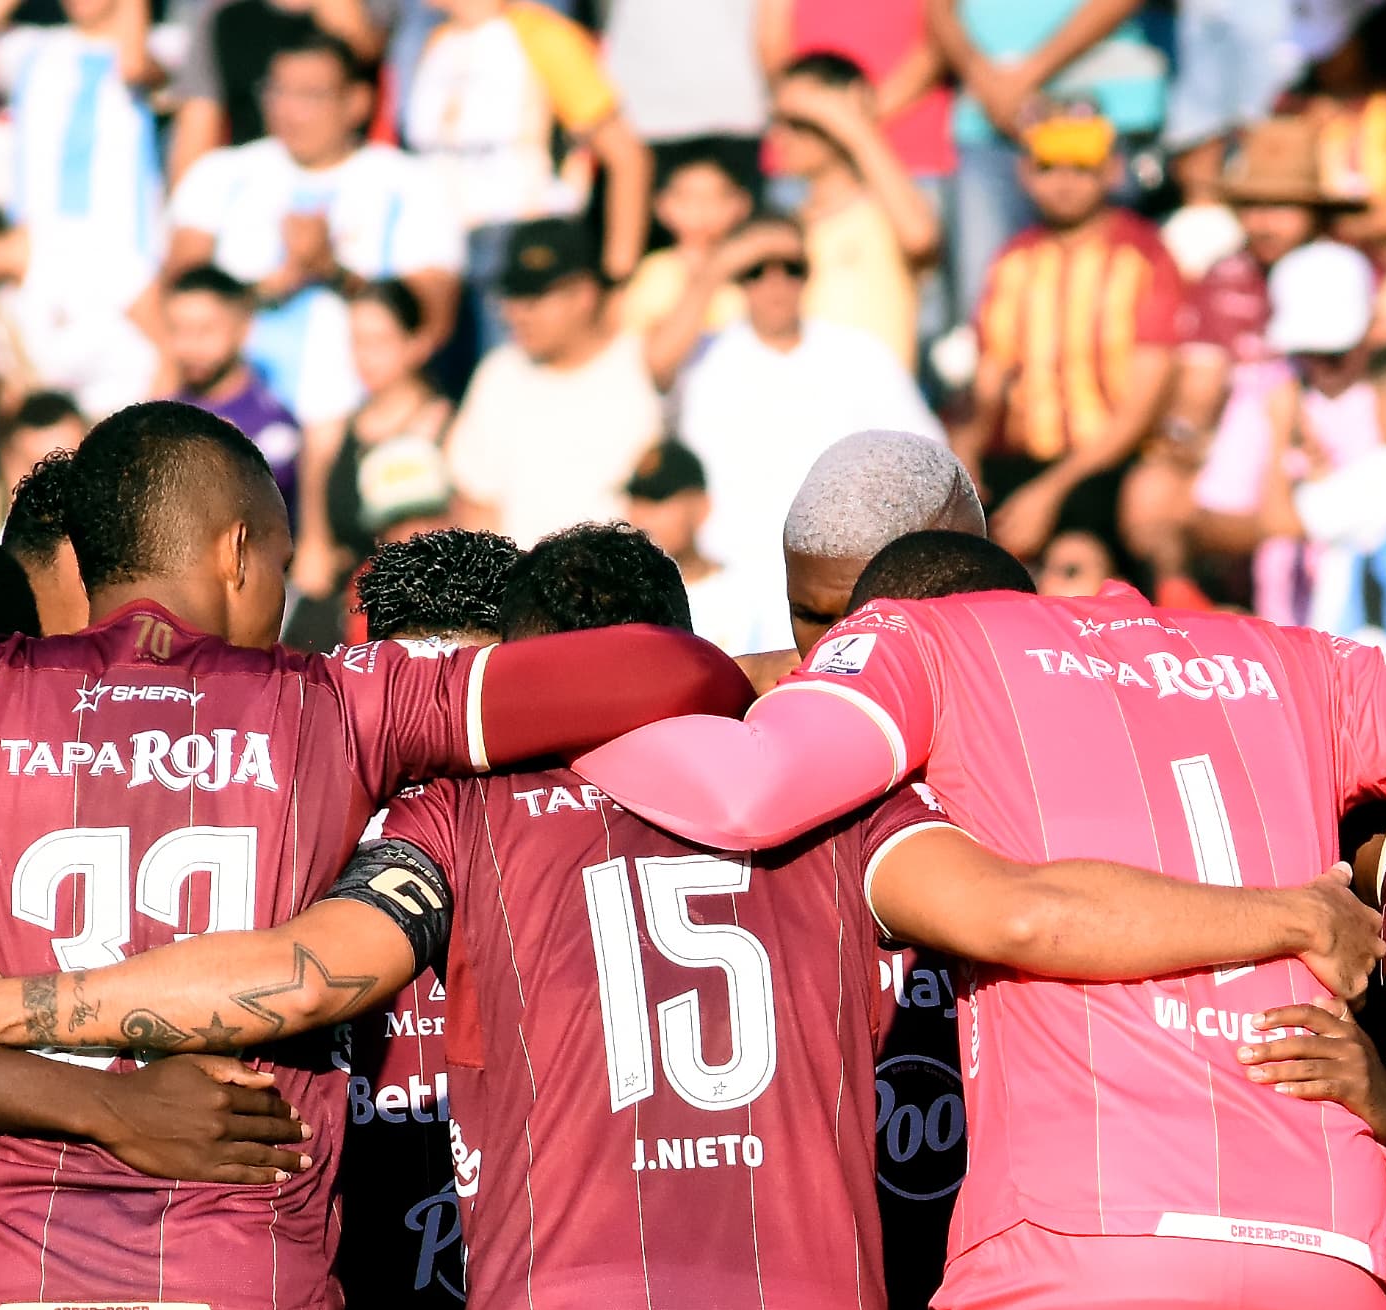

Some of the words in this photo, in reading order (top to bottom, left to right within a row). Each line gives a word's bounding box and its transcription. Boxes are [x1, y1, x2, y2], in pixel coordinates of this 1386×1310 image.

[110, 684, 206, 707] SHEFFY
[1024, 648, 1153, 689] TAPA
[1143, 651, 1280, 701] ROJA
[0, 738, 127, 777] TAPA
[125, 728, 280, 793] ROJA
[513, 783, 622, 819] TAP
[581, 852, 778, 1115] 15
[631, 1134, 765, 1173] J.NIETO
